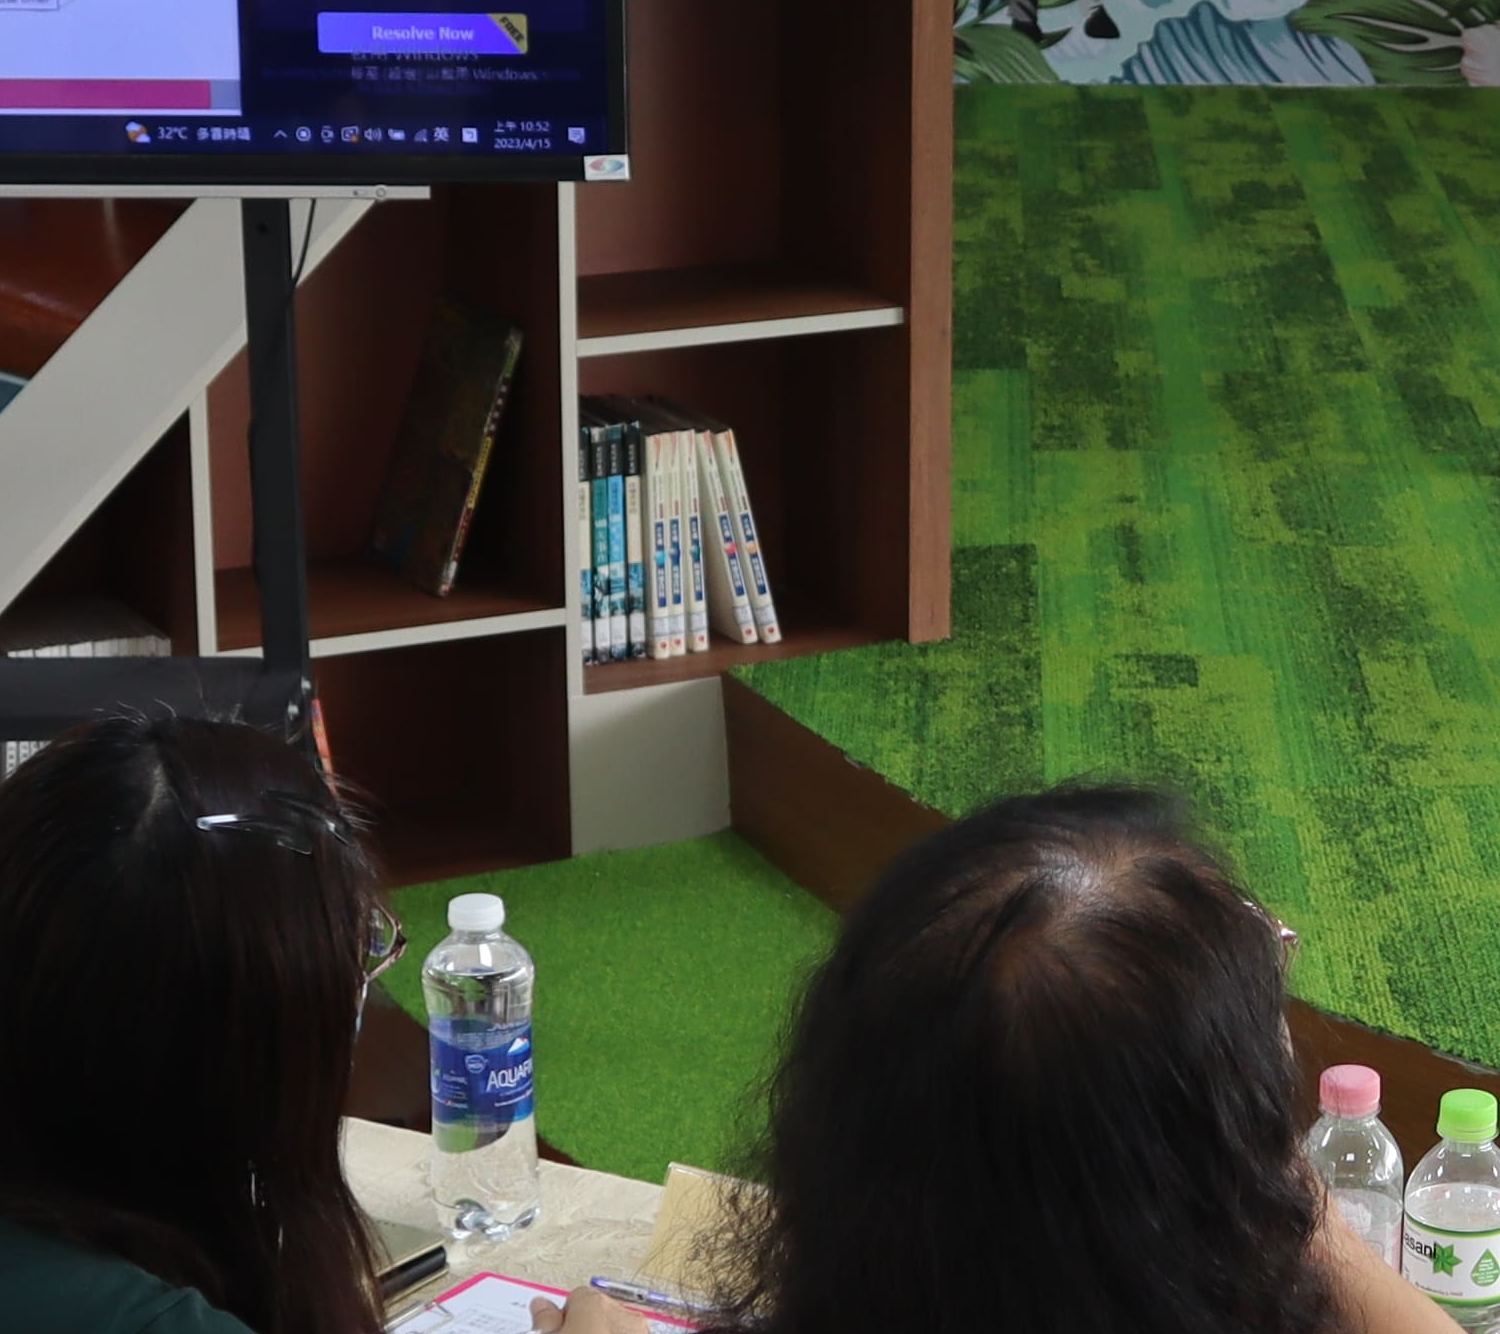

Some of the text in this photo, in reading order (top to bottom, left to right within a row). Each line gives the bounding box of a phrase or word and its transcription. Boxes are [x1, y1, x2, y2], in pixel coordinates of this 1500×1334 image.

[372, 26, 474, 41] Resolve Now
[499, 16, 525, 44] FREE
[520, 122, 550, 134] 10:52
[494, 136, 551, 150] 2023/4/15
[1404, 1231, 1438, 1261] asani
